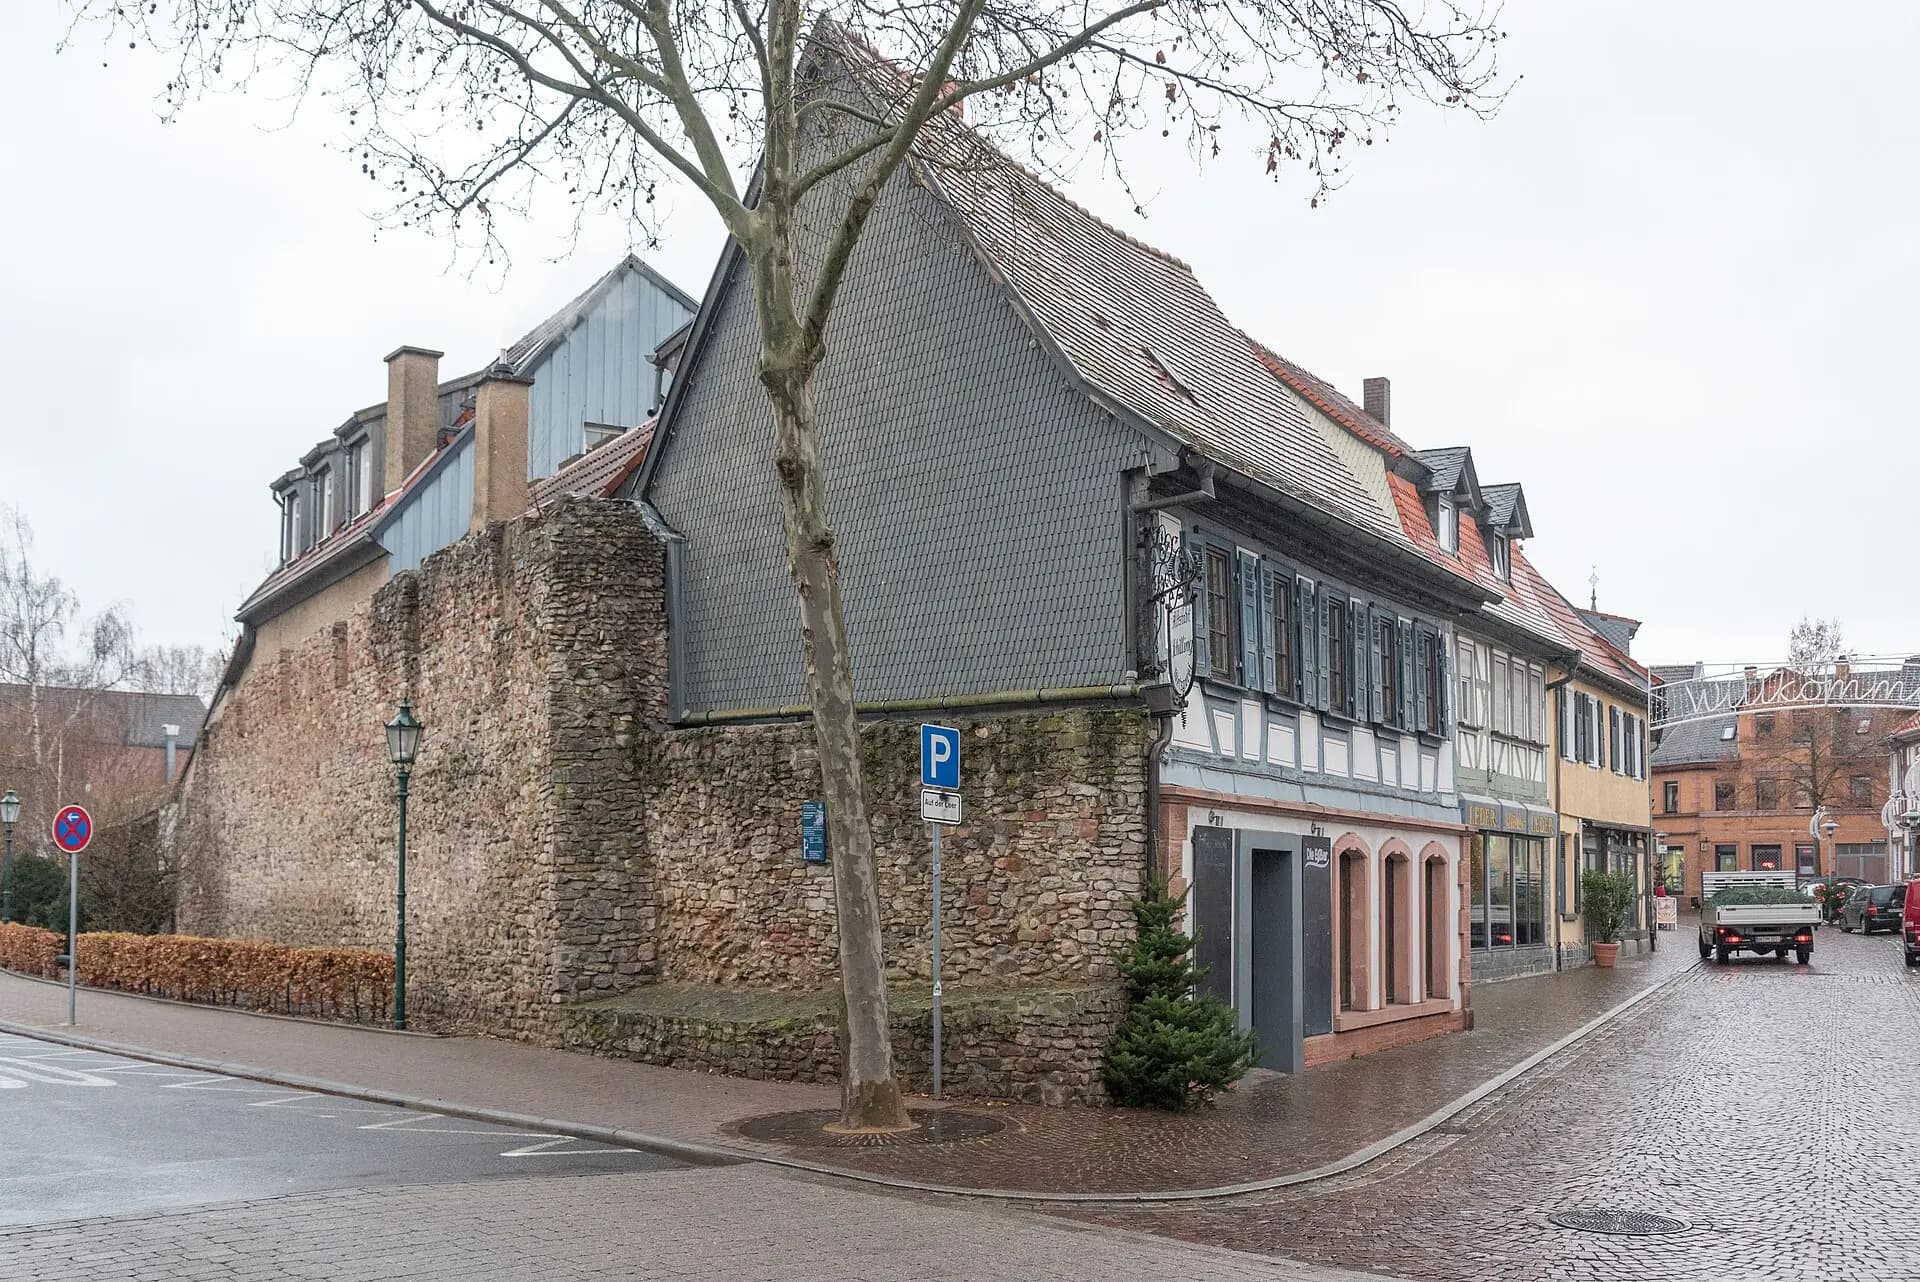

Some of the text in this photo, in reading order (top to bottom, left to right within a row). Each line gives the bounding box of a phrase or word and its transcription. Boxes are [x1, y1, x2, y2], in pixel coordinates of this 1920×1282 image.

[1684, 667, 1920, 712] Willkomm
[931, 733, 951, 779] P
[924, 798, 933, 807] Auf
[934, 799, 944, 807] der
[1469, 806, 1497, 828] LEDER
[1531, 814, 1554, 835] LEDER
